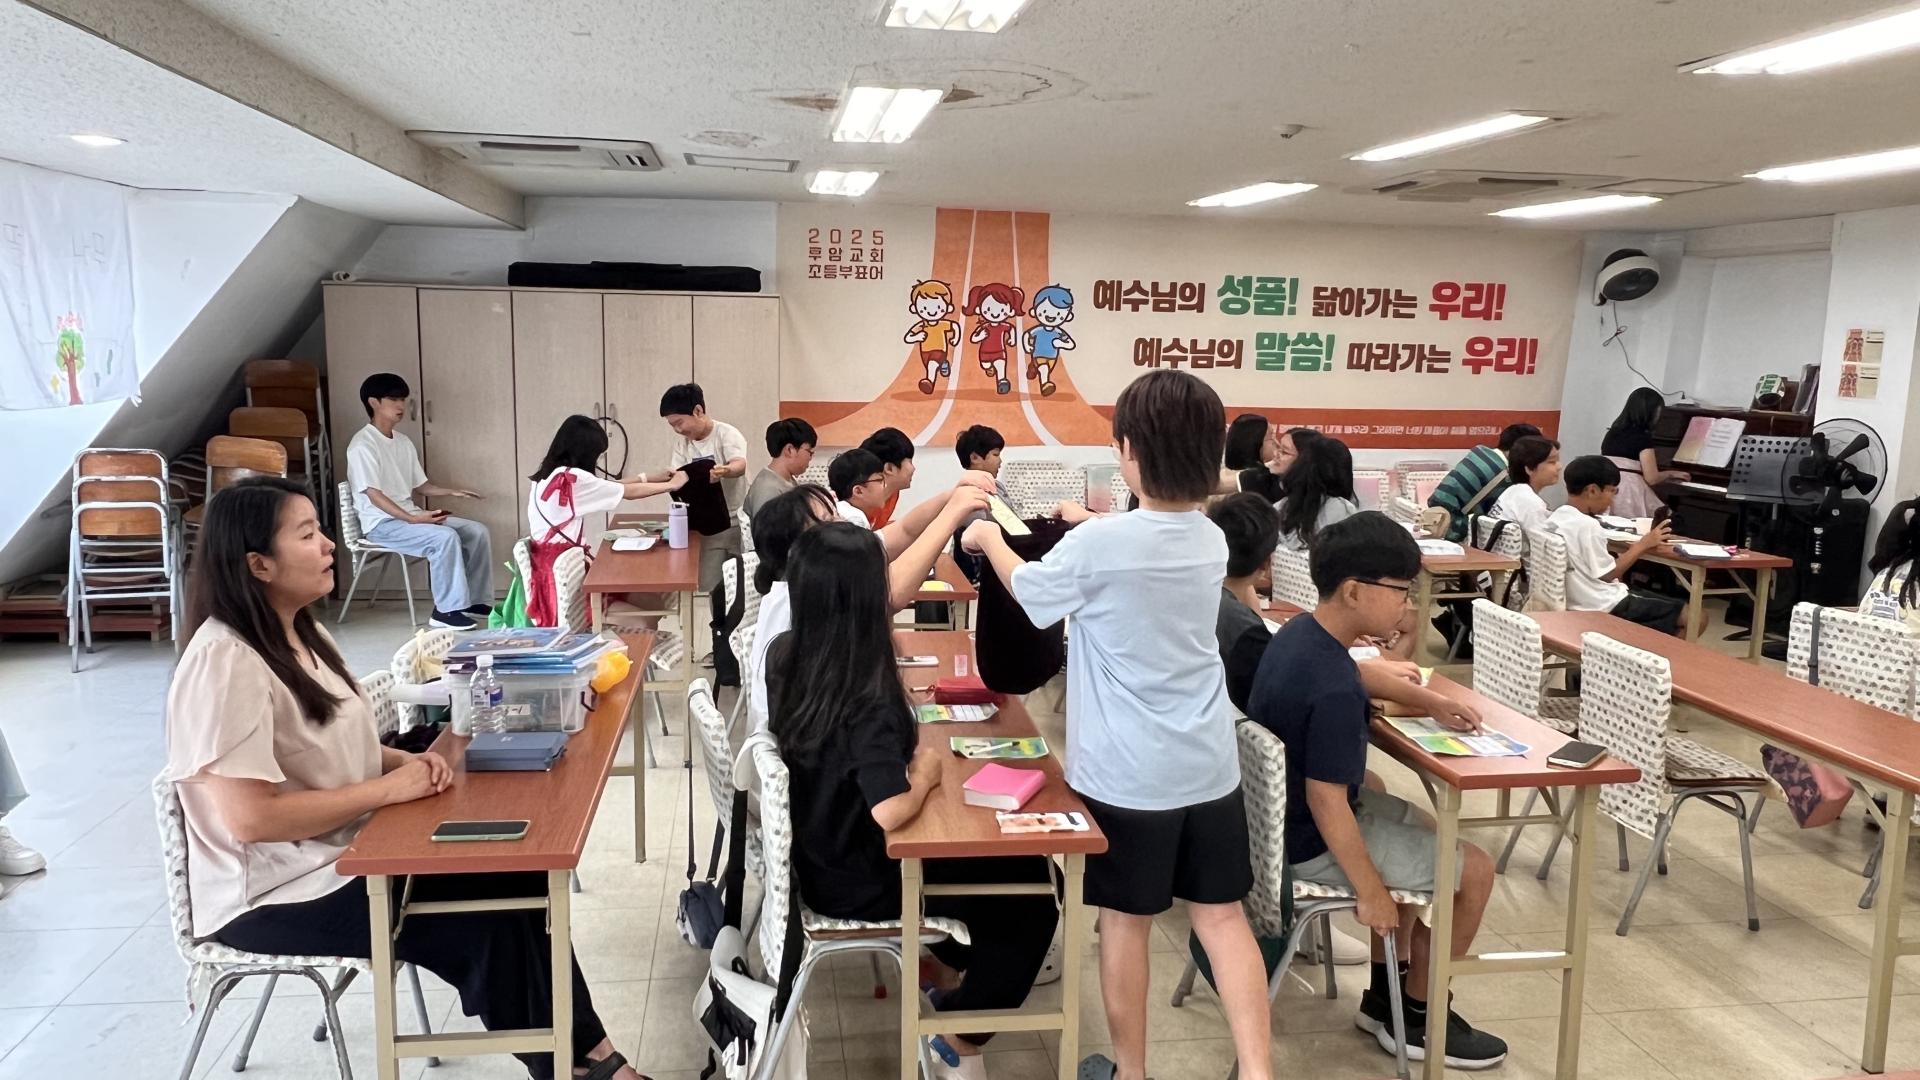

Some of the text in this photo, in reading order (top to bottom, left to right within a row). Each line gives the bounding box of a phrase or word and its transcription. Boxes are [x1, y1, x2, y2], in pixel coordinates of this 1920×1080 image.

[808, 227, 884, 246] 2025
[808, 246, 884, 263] 후암교회
[1093, 275, 1506, 321] 예수님의 성품! 닮아가는 우리!
[1133, 332, 1539, 375] 예수님의 말씀! 따라가는 우리!
